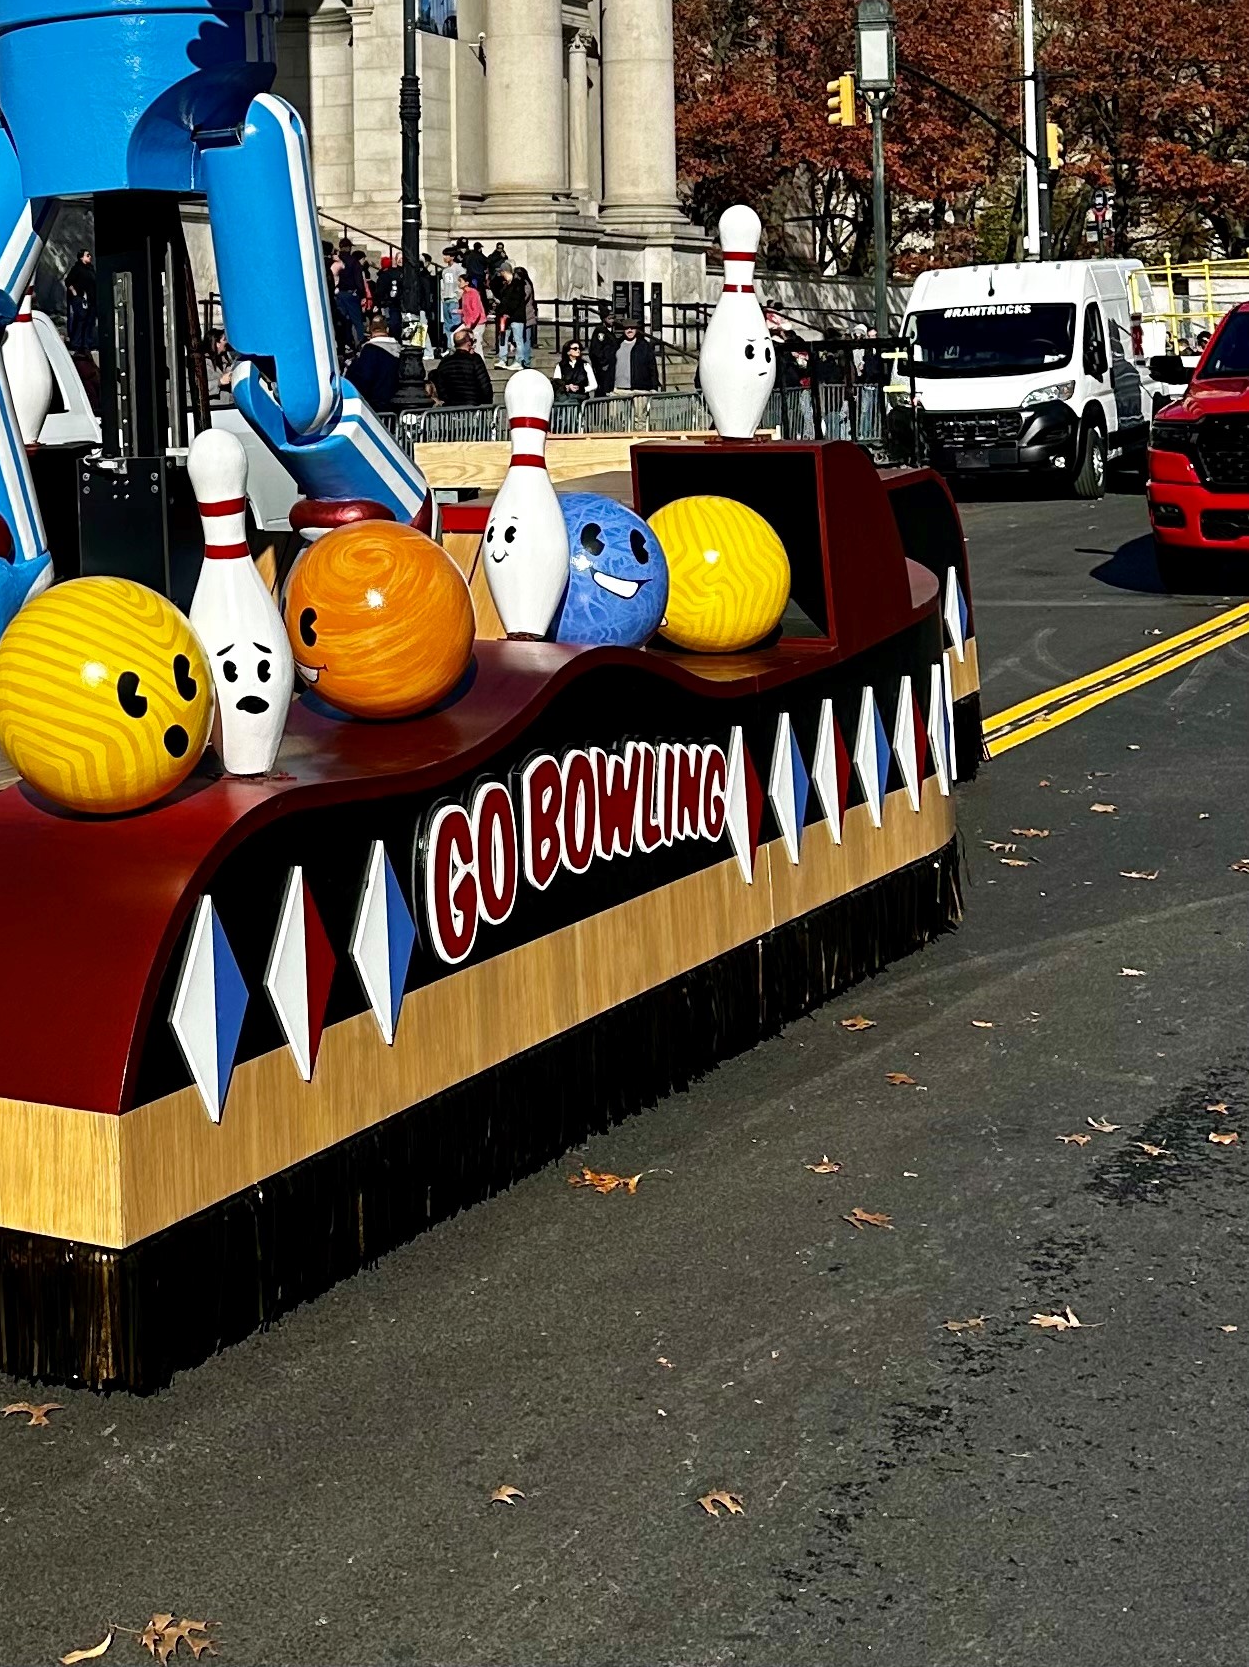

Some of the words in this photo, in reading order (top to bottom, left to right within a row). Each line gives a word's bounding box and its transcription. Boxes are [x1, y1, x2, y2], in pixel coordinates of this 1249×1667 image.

[944, 305, 1032, 318] #RAMTRUCKS
[427, 782, 518, 964] GO
[522, 741, 727, 891] BOWLING
